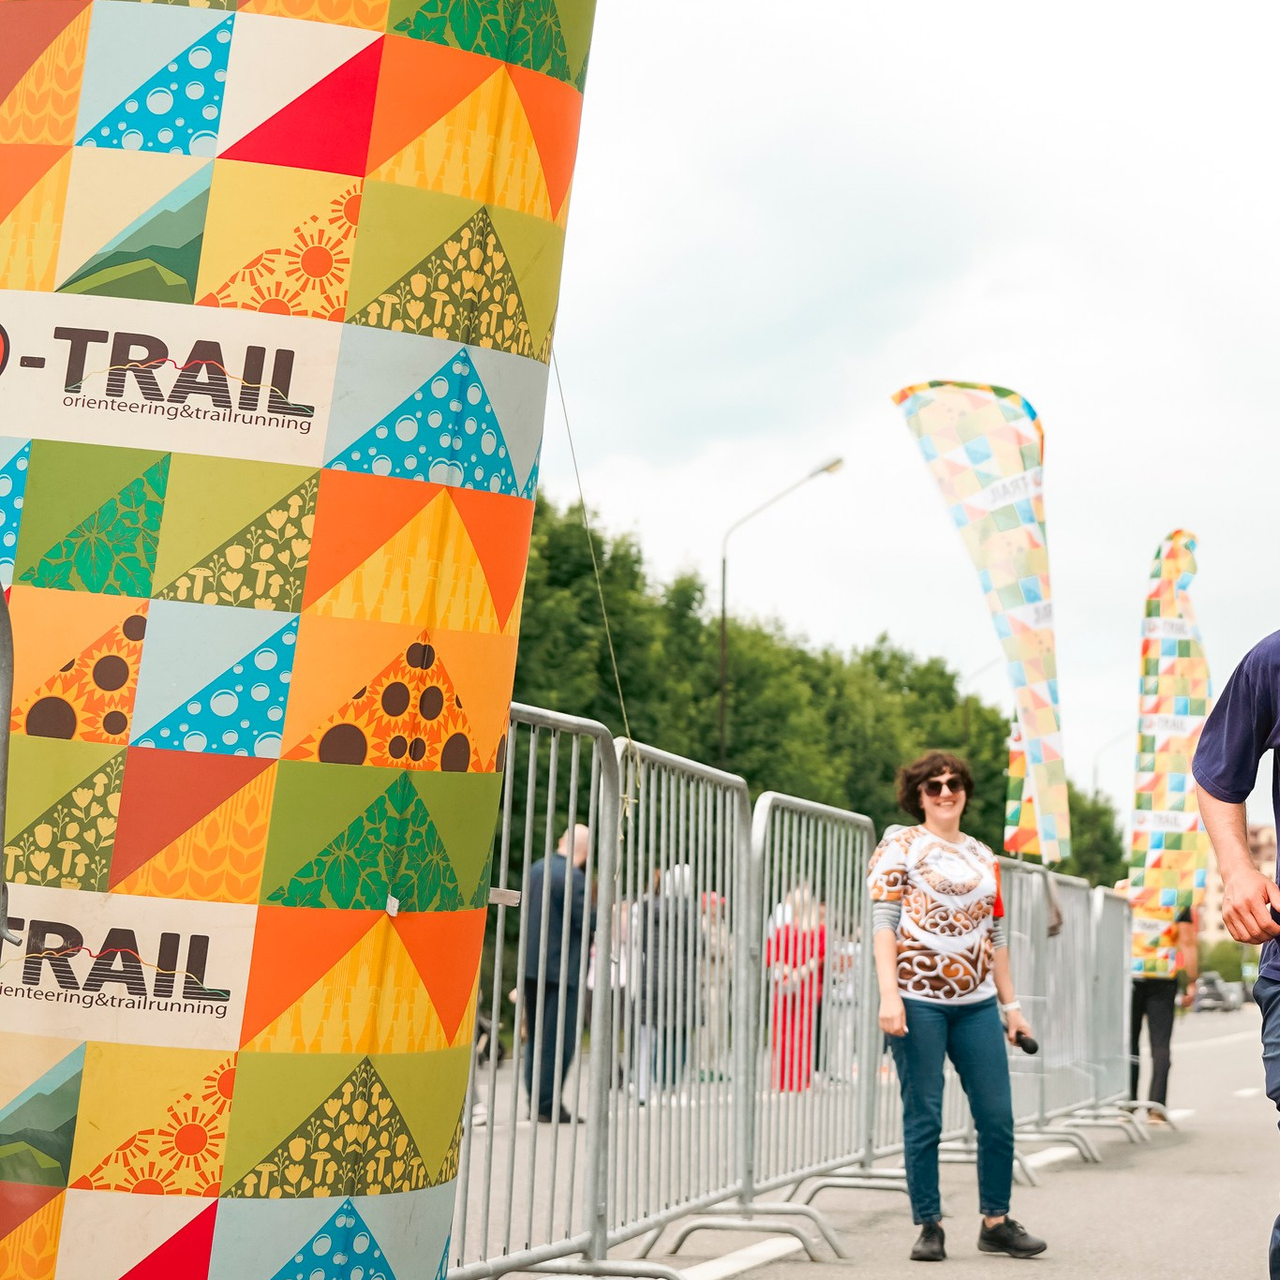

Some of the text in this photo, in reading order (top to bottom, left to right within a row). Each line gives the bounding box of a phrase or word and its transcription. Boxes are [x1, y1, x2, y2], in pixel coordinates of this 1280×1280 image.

[0, 323, 315, 418] -TRAIL
[62, 393, 312, 435] orienteering&trailrunning
[0, 981, 228, 1020] ienteering&trailrunning
